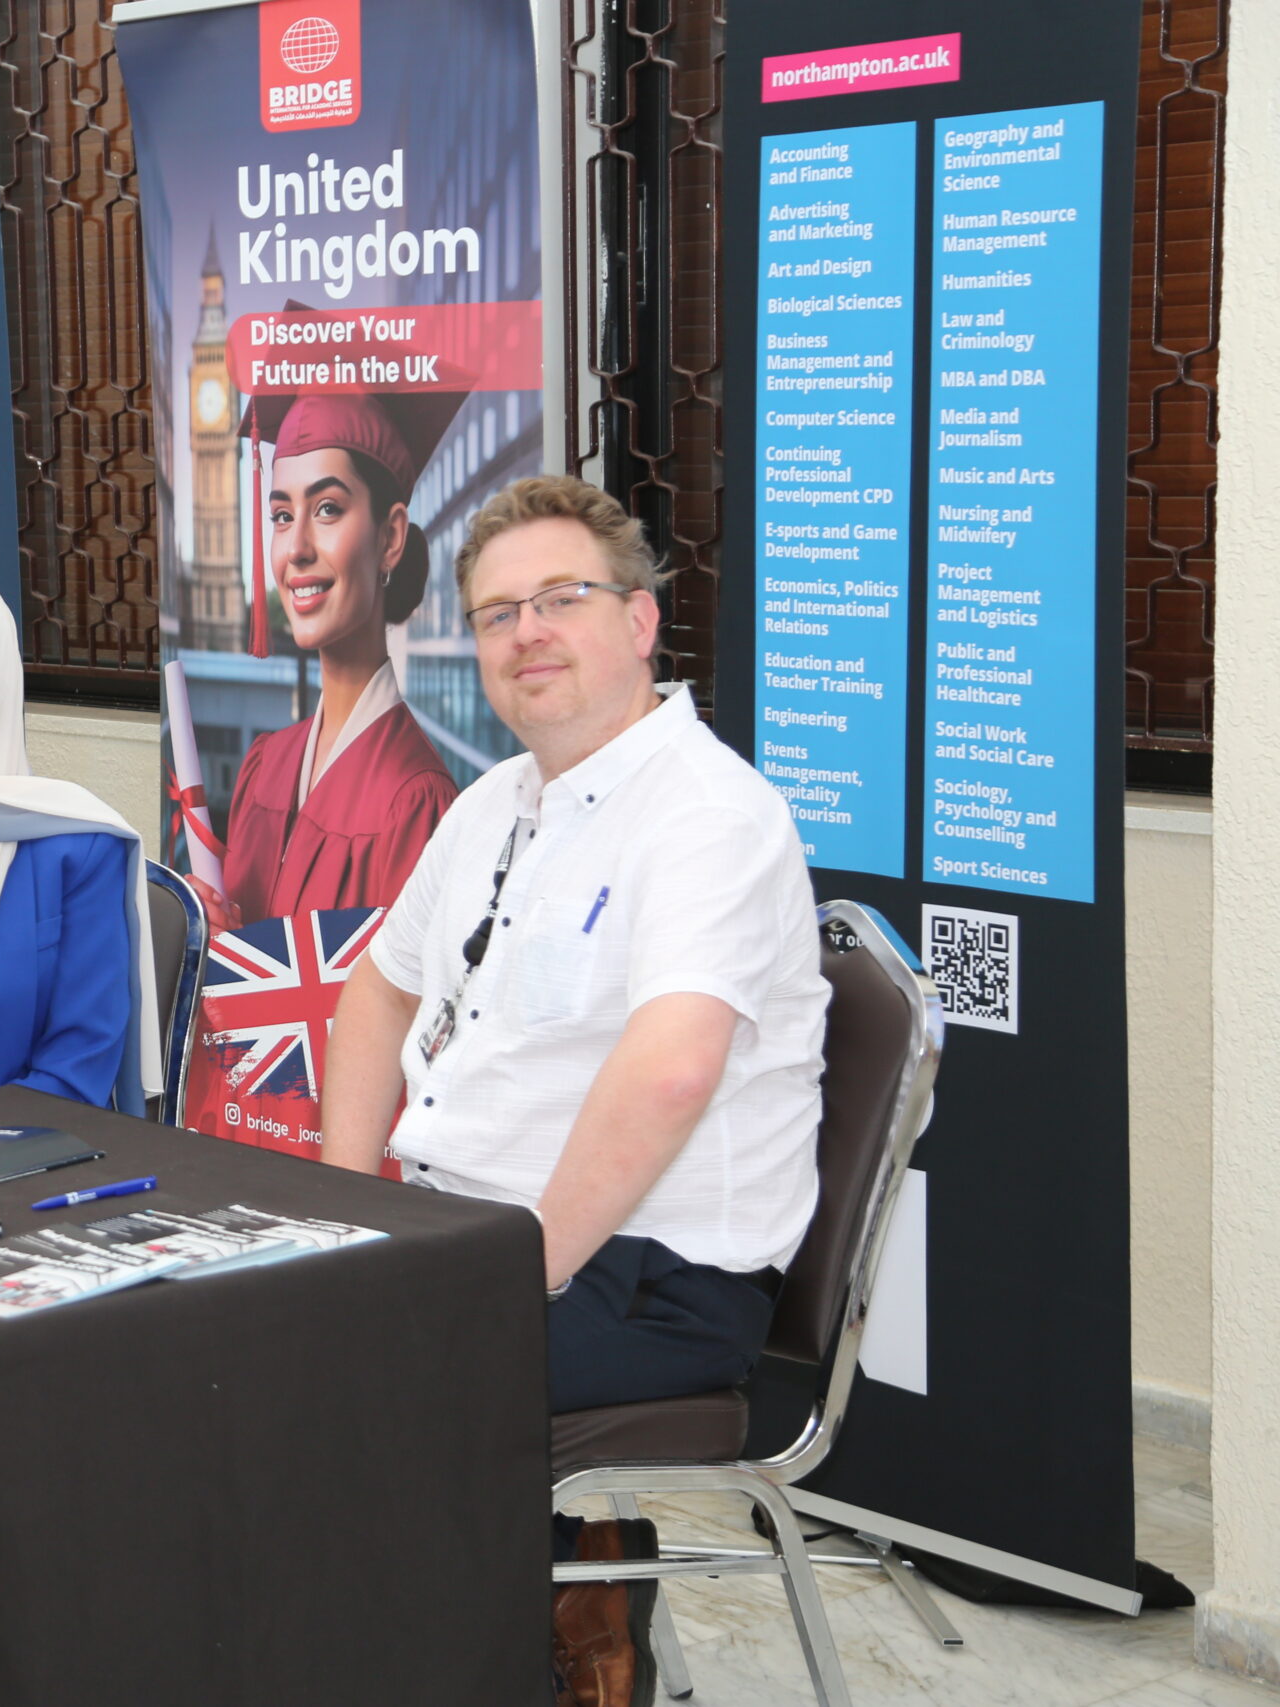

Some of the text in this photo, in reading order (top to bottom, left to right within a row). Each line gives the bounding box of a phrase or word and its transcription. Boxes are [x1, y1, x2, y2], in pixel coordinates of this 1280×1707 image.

[772, 46, 950, 87] northampton.ac.uk
[269, 79, 352, 107] BRIDGE
[945, 119, 1064, 149] Geography and
[770, 143, 849, 164] Accounting
[944, 143, 1060, 170] Environmental
[238, 149, 403, 219] United
[769, 164, 853, 185] and Finance
[944, 174, 1000, 192] Science
[768, 201, 850, 222] Advertising
[944, 207, 1077, 230] Human Resource
[768, 220, 873, 242] and Marketing
[943, 231, 1047, 254] Management
[239, 219, 480, 299] Kingdom
[768, 258, 872, 278] Art and Design
[943, 270, 1032, 290] Humanities
[768, 294, 902, 316] Biological Sciences
[942, 310, 1004, 328] Law and
[250, 316, 415, 346] Discover Your
[767, 333, 829, 349] Business
[942, 332, 1035, 352] Criminology
[251, 355, 439, 386] Future in the UK
[767, 351, 893, 373] Management and
[766, 373, 893, 394] Entrepreneurship
[941, 369, 1046, 387] MBA and DBA
[766, 410, 895, 430] Computer Science
[940, 408, 1019, 424] Media and
[938, 430, 1022, 450] Journalism
[766, 445, 842, 466] Continuing
[766, 467, 852, 483] Professional
[939, 468, 1054, 484] Music and Arts
[765, 488, 893, 507] Development CPD
[939, 505, 1032, 525] Nursing and
[765, 522, 898, 542] E-sports and Game
[939, 527, 1016, 548] Midwifery
[765, 543, 860, 563] Development
[938, 564, 992, 583] Project
[765, 577, 899, 598] Economics, Politics
[938, 585, 1041, 606] Management
[765, 599, 889, 619] and International
[938, 607, 1038, 628] and Logistics
[765, 618, 829, 636] Relations
[764, 652, 865, 674] Education and
[937, 643, 1016, 663] Public and
[937, 664, 1032, 686] Professional
[764, 672, 883, 700] Teacher Training
[936, 685, 1022, 707] Healthcare
[764, 706, 847, 732] Engineering
[936, 721, 1027, 744] Social Work
[764, 741, 808, 760] Events
[936, 744, 1054, 768] and Social Care
[764, 761, 863, 787] Management,
[935, 779, 1012, 804] Sociology,
[790, 804, 852, 824] Tourism
[935, 800, 1057, 827] Psychology and
[934, 821, 1026, 849] Counselling
[934, 857, 1047, 885] Sport Sciences
